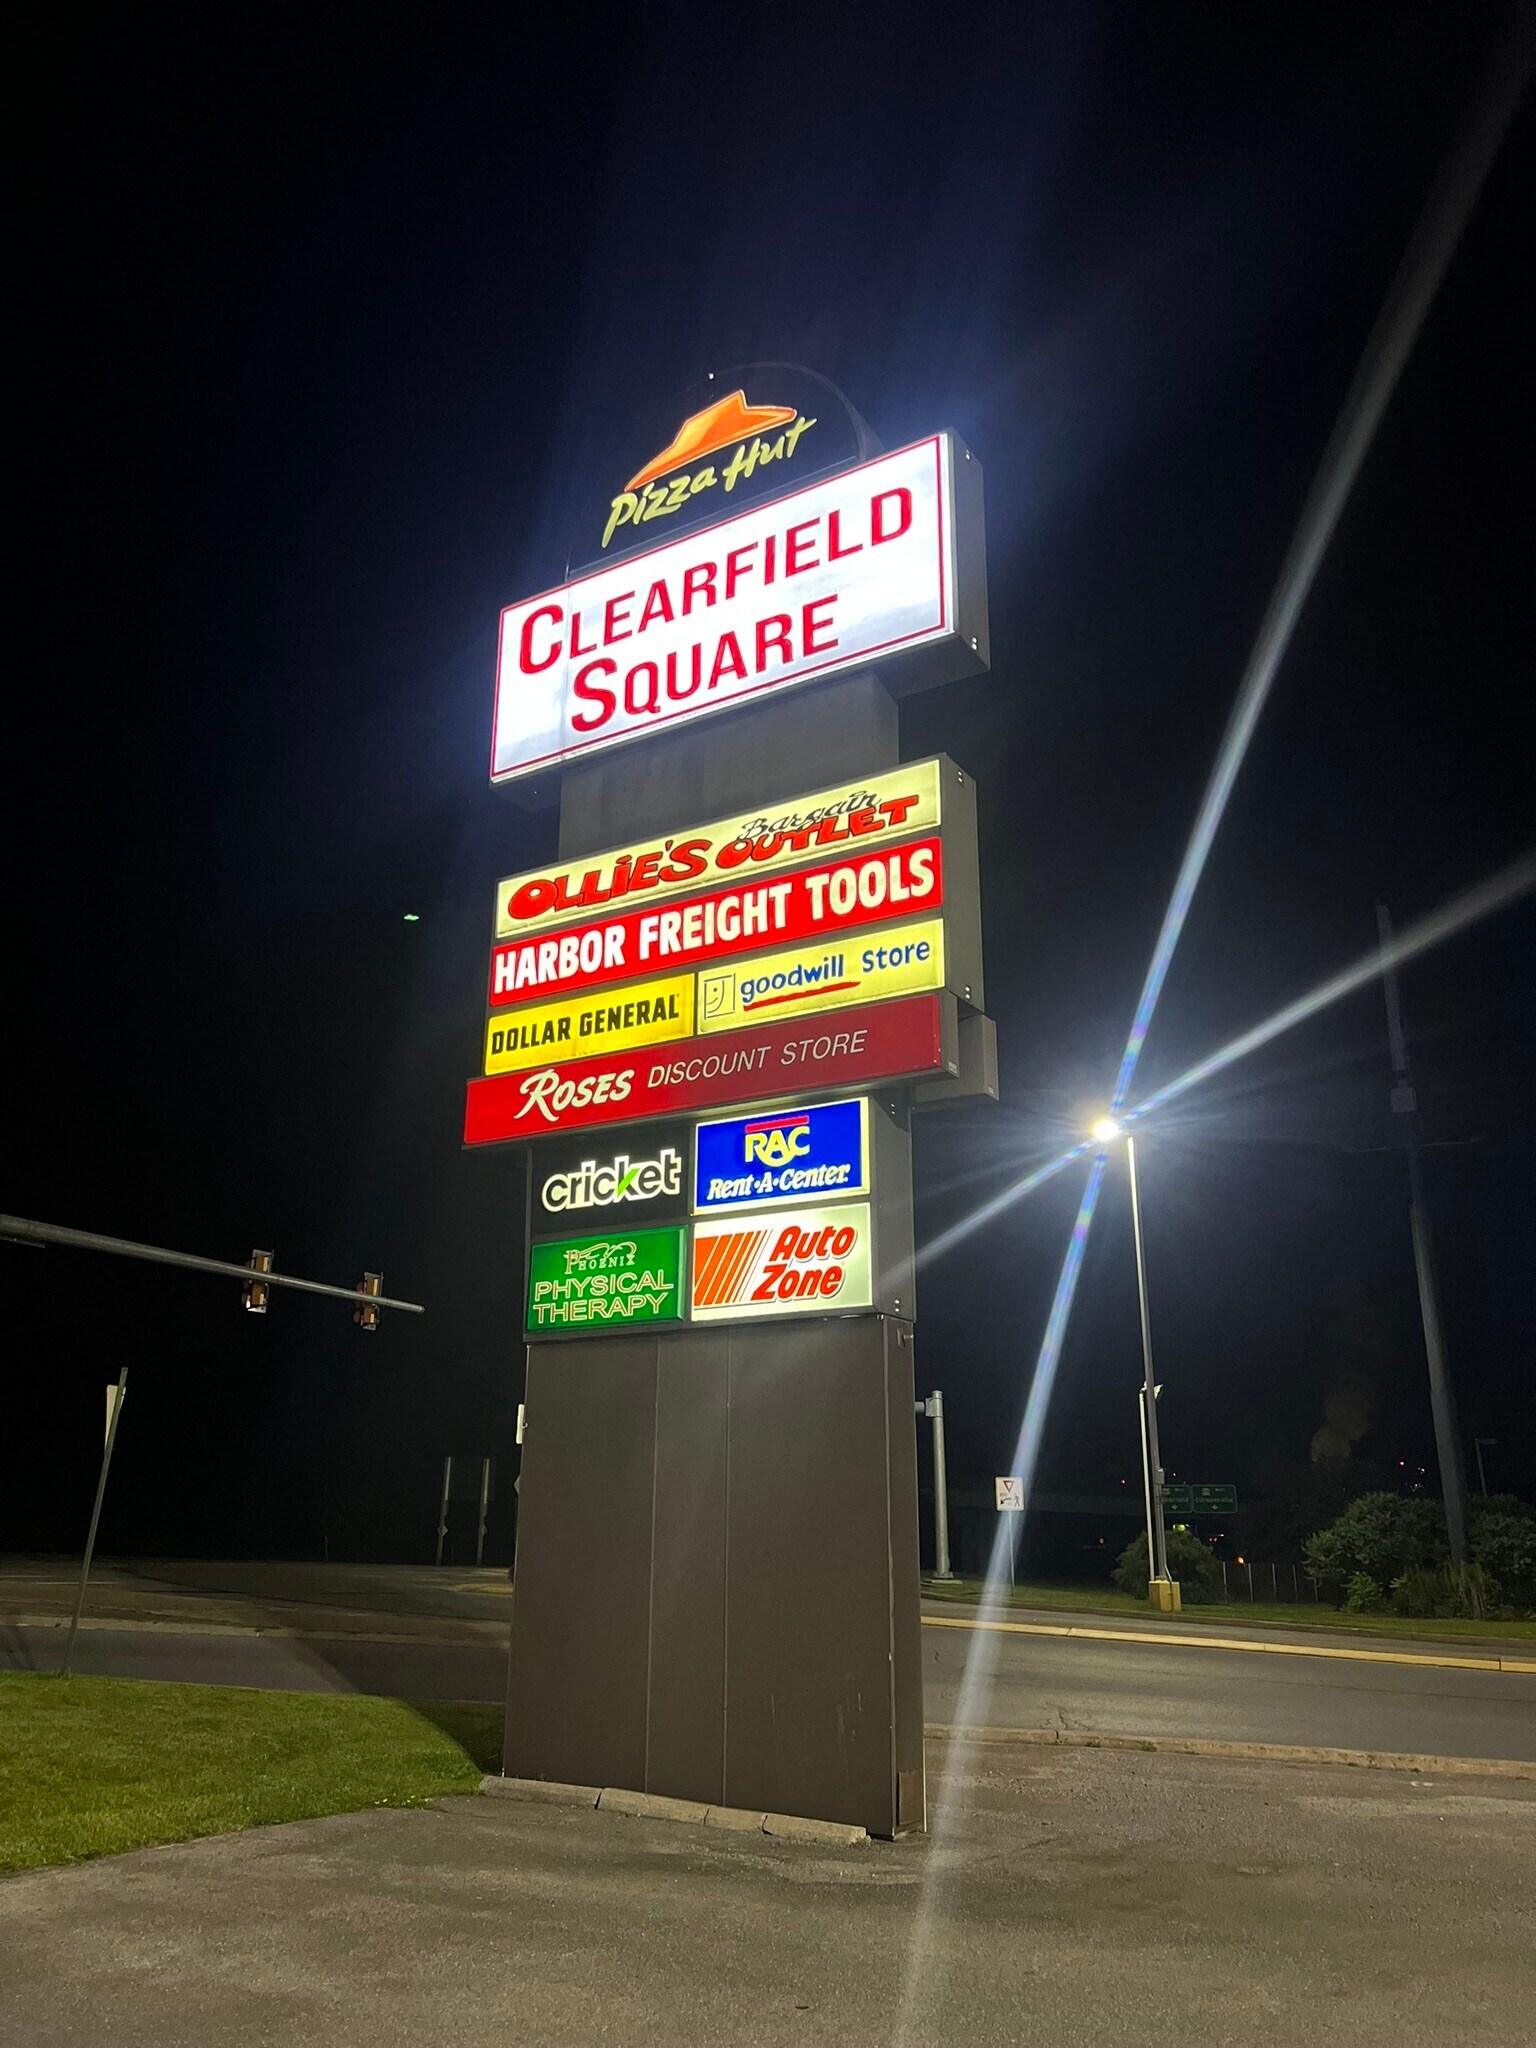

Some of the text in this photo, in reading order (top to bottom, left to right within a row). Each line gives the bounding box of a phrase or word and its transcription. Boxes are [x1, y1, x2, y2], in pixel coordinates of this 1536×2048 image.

[602, 416, 817, 548] Pizza Hut
[518, 486, 912, 675] CLEARFIELD
[570, 594, 839, 732] SQUARE
[715, 795, 920, 869] OUTLET
[736, 790, 882, 841] Bargain
[494, 848, 935, 996] HARBOR FREIGHT TOOLS
[740, 938, 931, 1004] goodwill Store
[491, 994, 681, 1056] DOLLAR GENERAL
[514, 1030, 868, 1122] ROSES DISCOUNT STORE
[744, 1126, 810, 1168] RAC
[542, 1148, 682, 1213] cricket
[563, 1249, 636, 1275] PHOENIX
[768, 1225, 856, 1263] Auto
[533, 1292, 669, 1324] THERAPY
[534, 1269, 674, 1302] PHYSICAL
[750, 1264, 843, 1301] Zone
